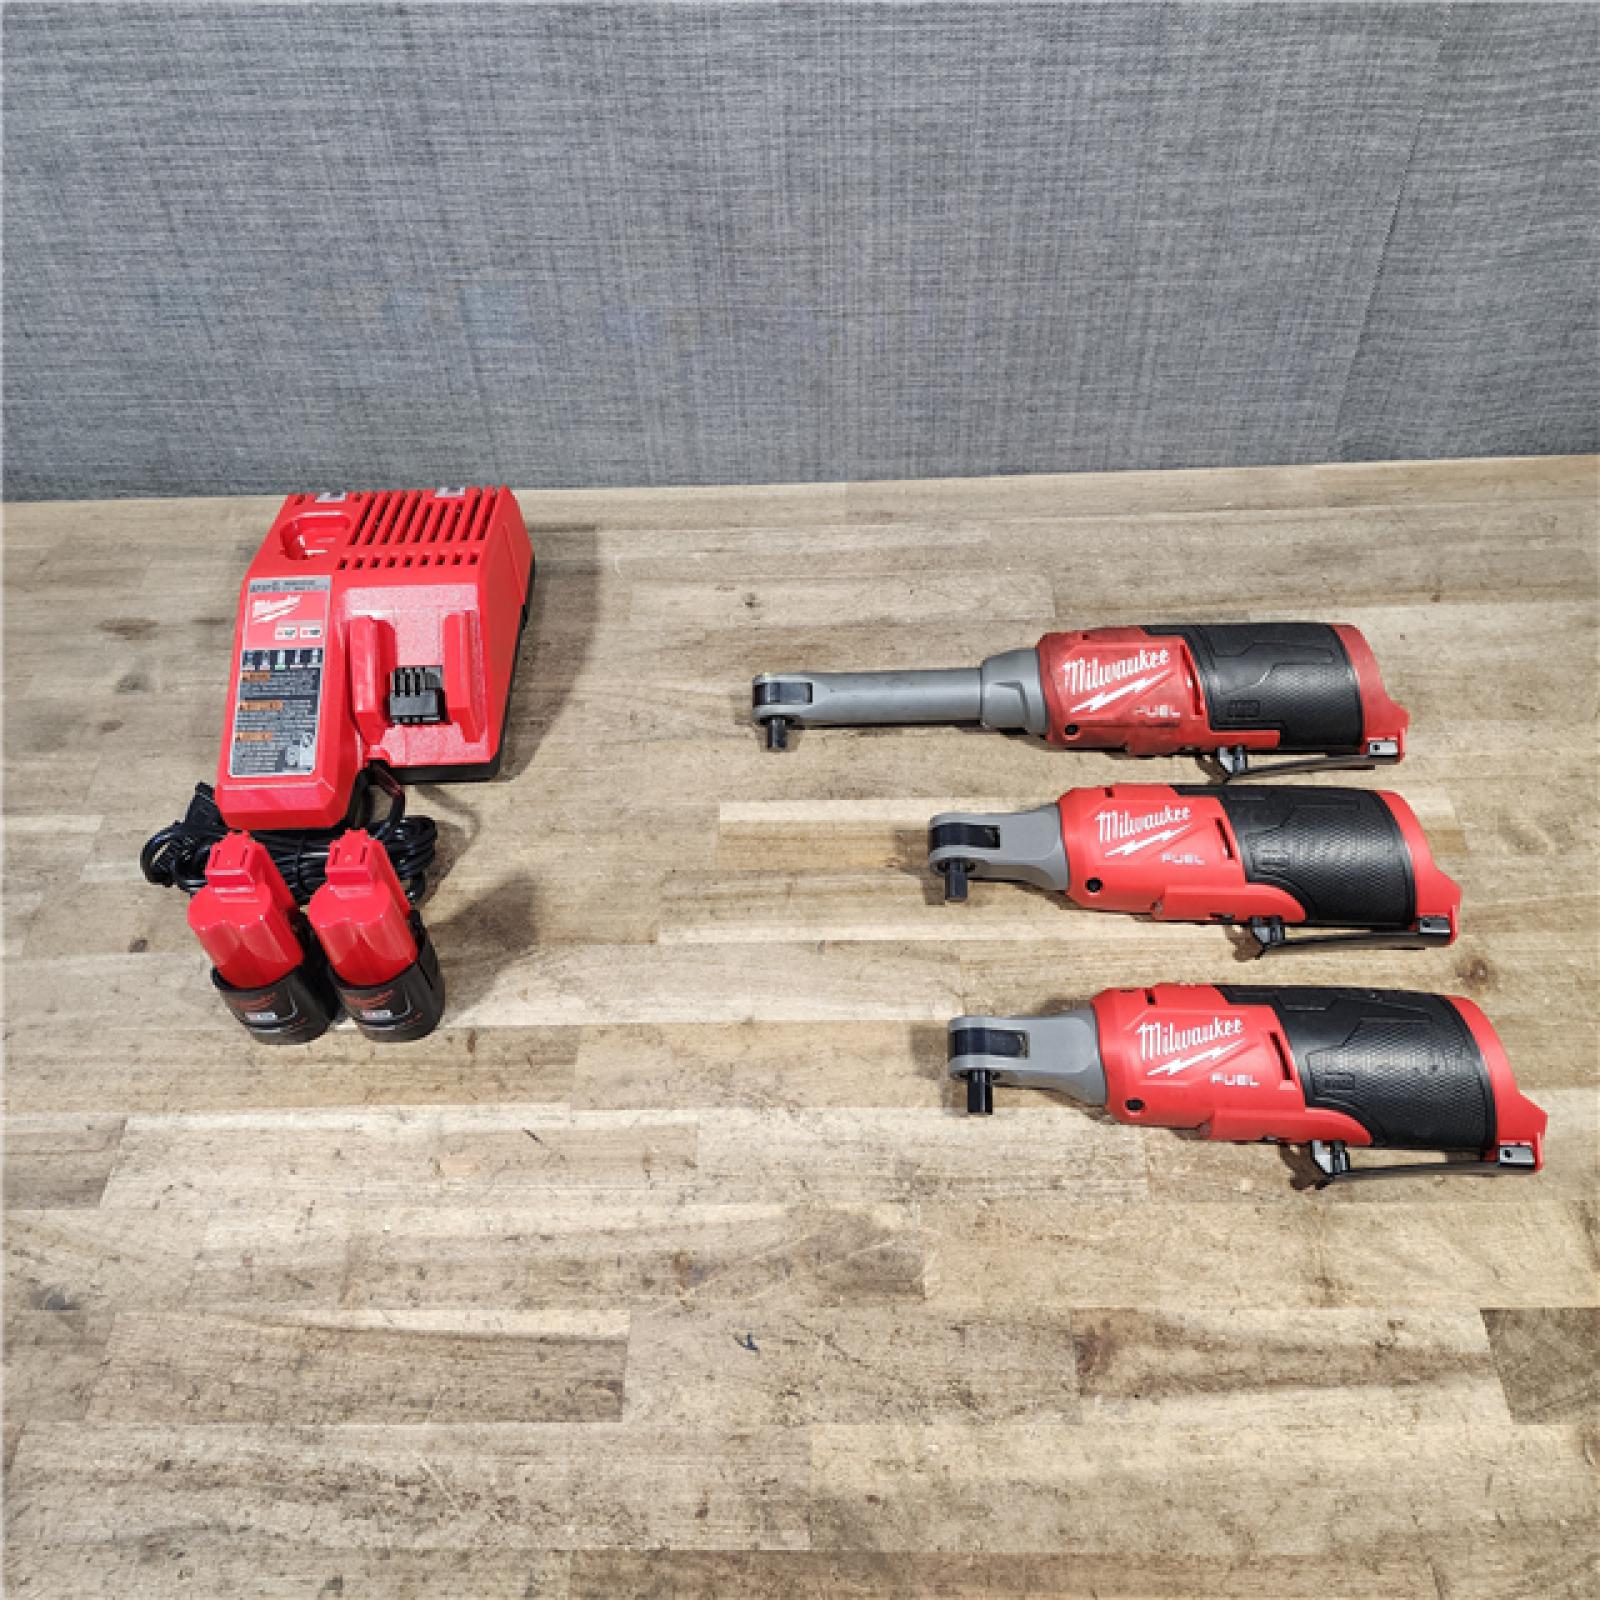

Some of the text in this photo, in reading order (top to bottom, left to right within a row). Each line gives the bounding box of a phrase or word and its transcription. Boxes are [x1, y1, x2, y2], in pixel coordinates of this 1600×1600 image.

[1062, 649, 1169, 695] Milwaukee
[1095, 805, 1192, 844] Milwaukee
[1161, 853, 1206, 866] FUEL
[1136, 1016, 1244, 1061] Milwaukee
[1210, 1072, 1260, 1086] FUEL
